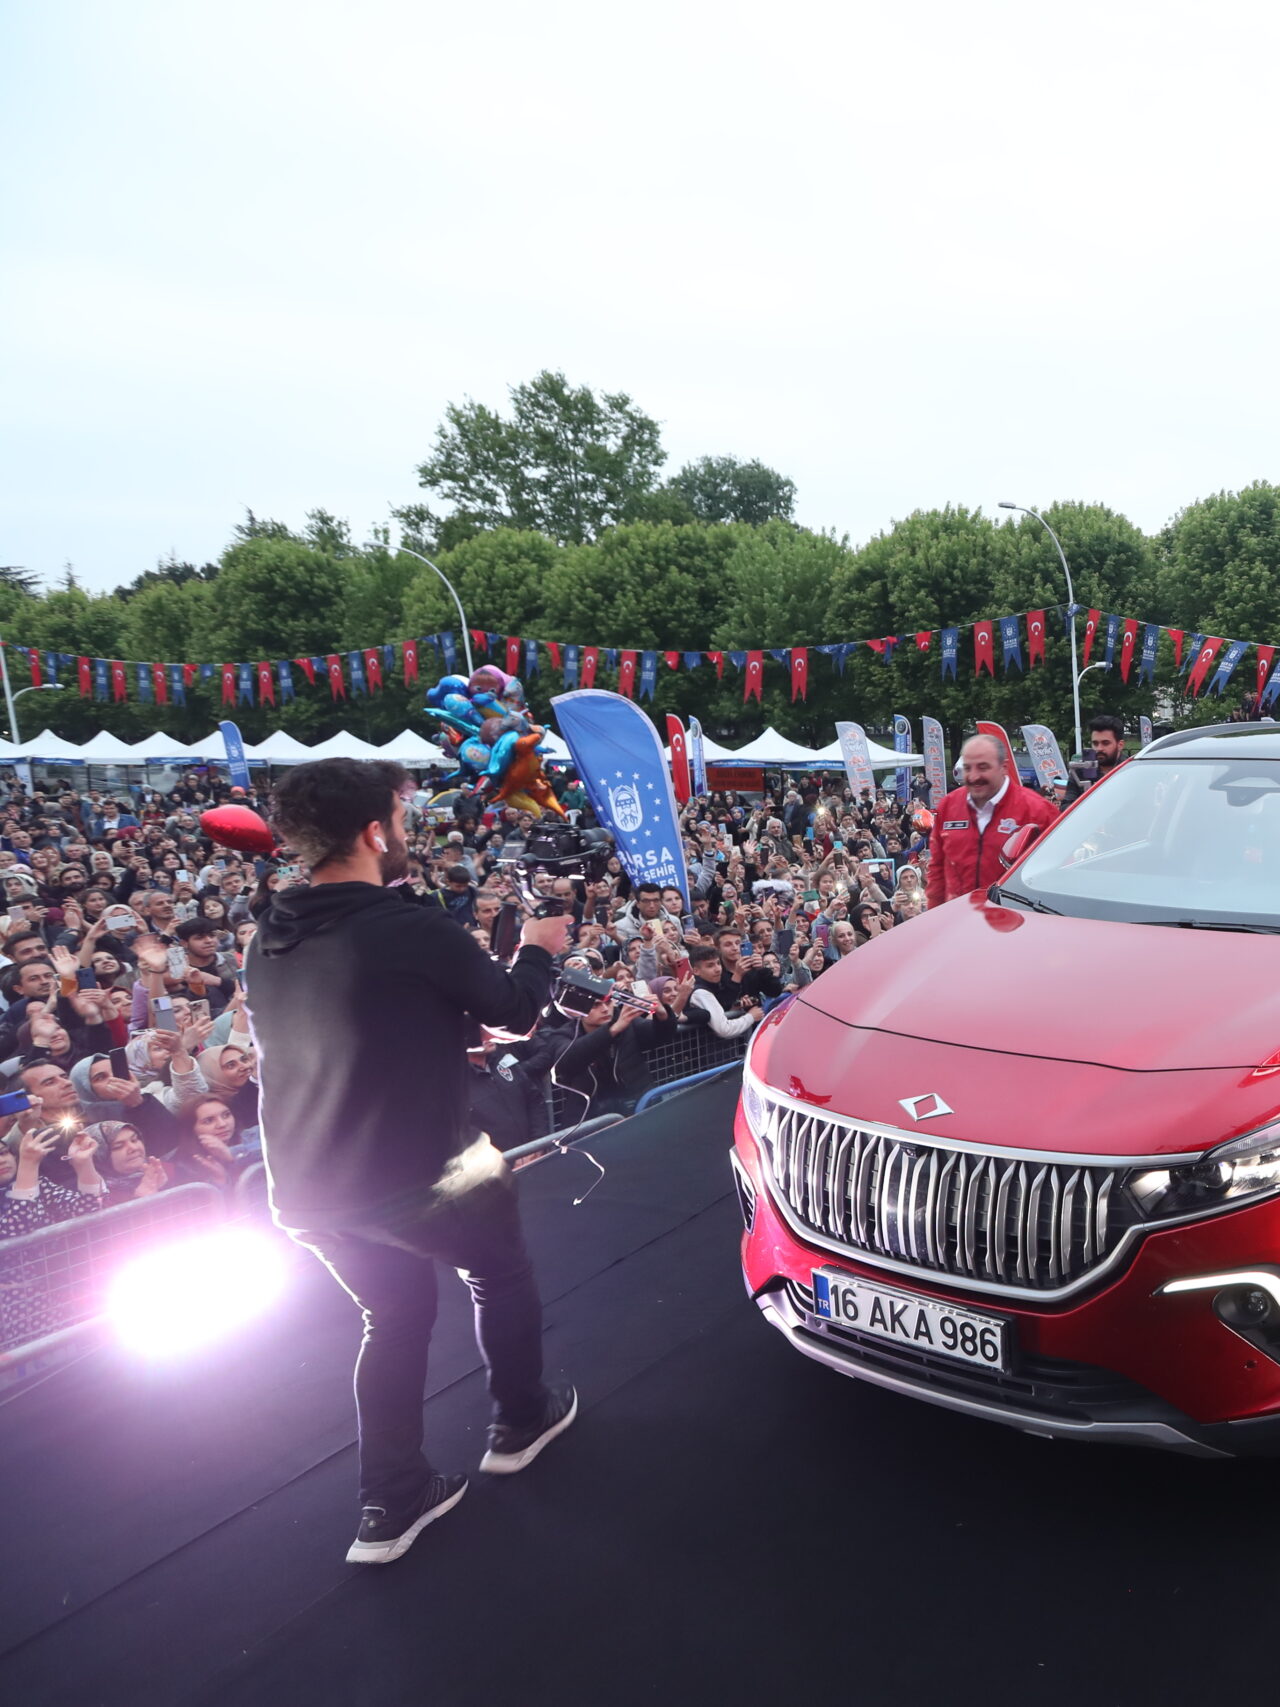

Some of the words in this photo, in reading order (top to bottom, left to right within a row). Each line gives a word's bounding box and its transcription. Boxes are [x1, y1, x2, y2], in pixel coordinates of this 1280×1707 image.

[817, 1298, 830, 1311] TR
[830, 1284, 859, 1322] 16
[868, 1296, 934, 1345] AKA
[939, 1316, 999, 1362] 986
